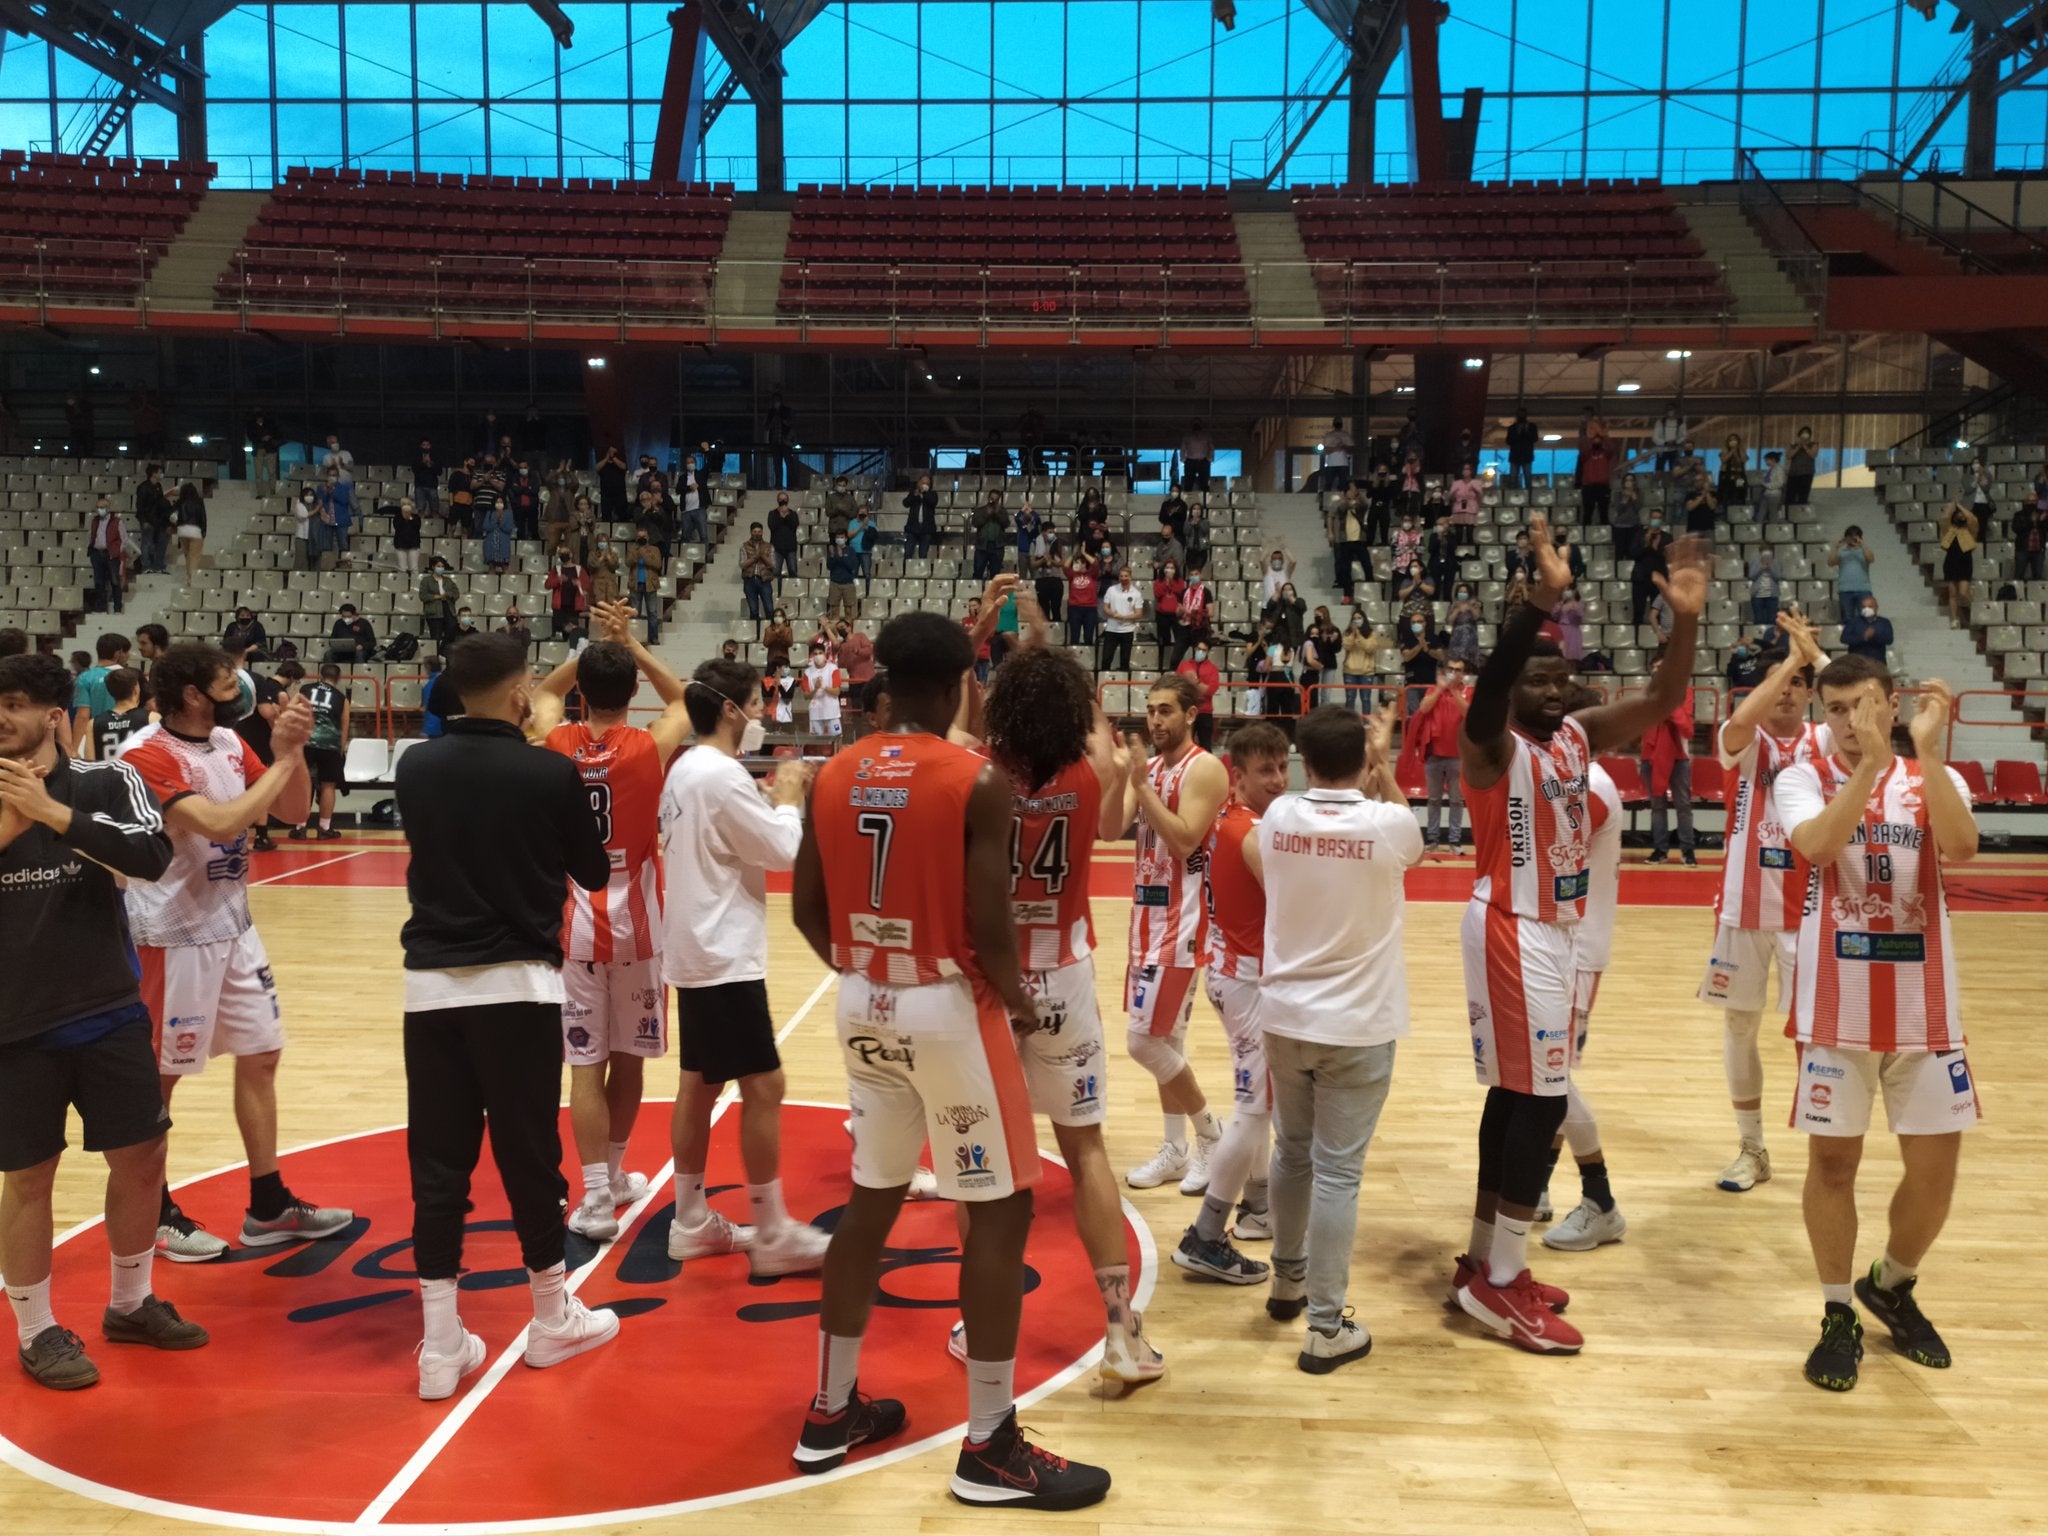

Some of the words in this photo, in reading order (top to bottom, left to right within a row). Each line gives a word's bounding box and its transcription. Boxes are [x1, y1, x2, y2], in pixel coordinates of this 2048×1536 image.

[310, 687, 332, 709] 11
[1509, 796, 1526, 868] O'RISON
[1523, 803, 1532, 862] RESTAURANTE
[1758, 821, 1787, 841] gij
[1873, 824, 1926, 849] BASKE
[1272, 831, 1312, 856] GIJÓN
[1316, 837, 1376, 860] BASKET
[858, 812, 895, 909] 7
[1865, 853, 1893, 883] 18
[1, 867, 60, 884] adidas
[1801, 864, 1816, 916] O'RIS
[1051, 1001, 1066, 1012] del
[936, 1112, 950, 1126] LA
